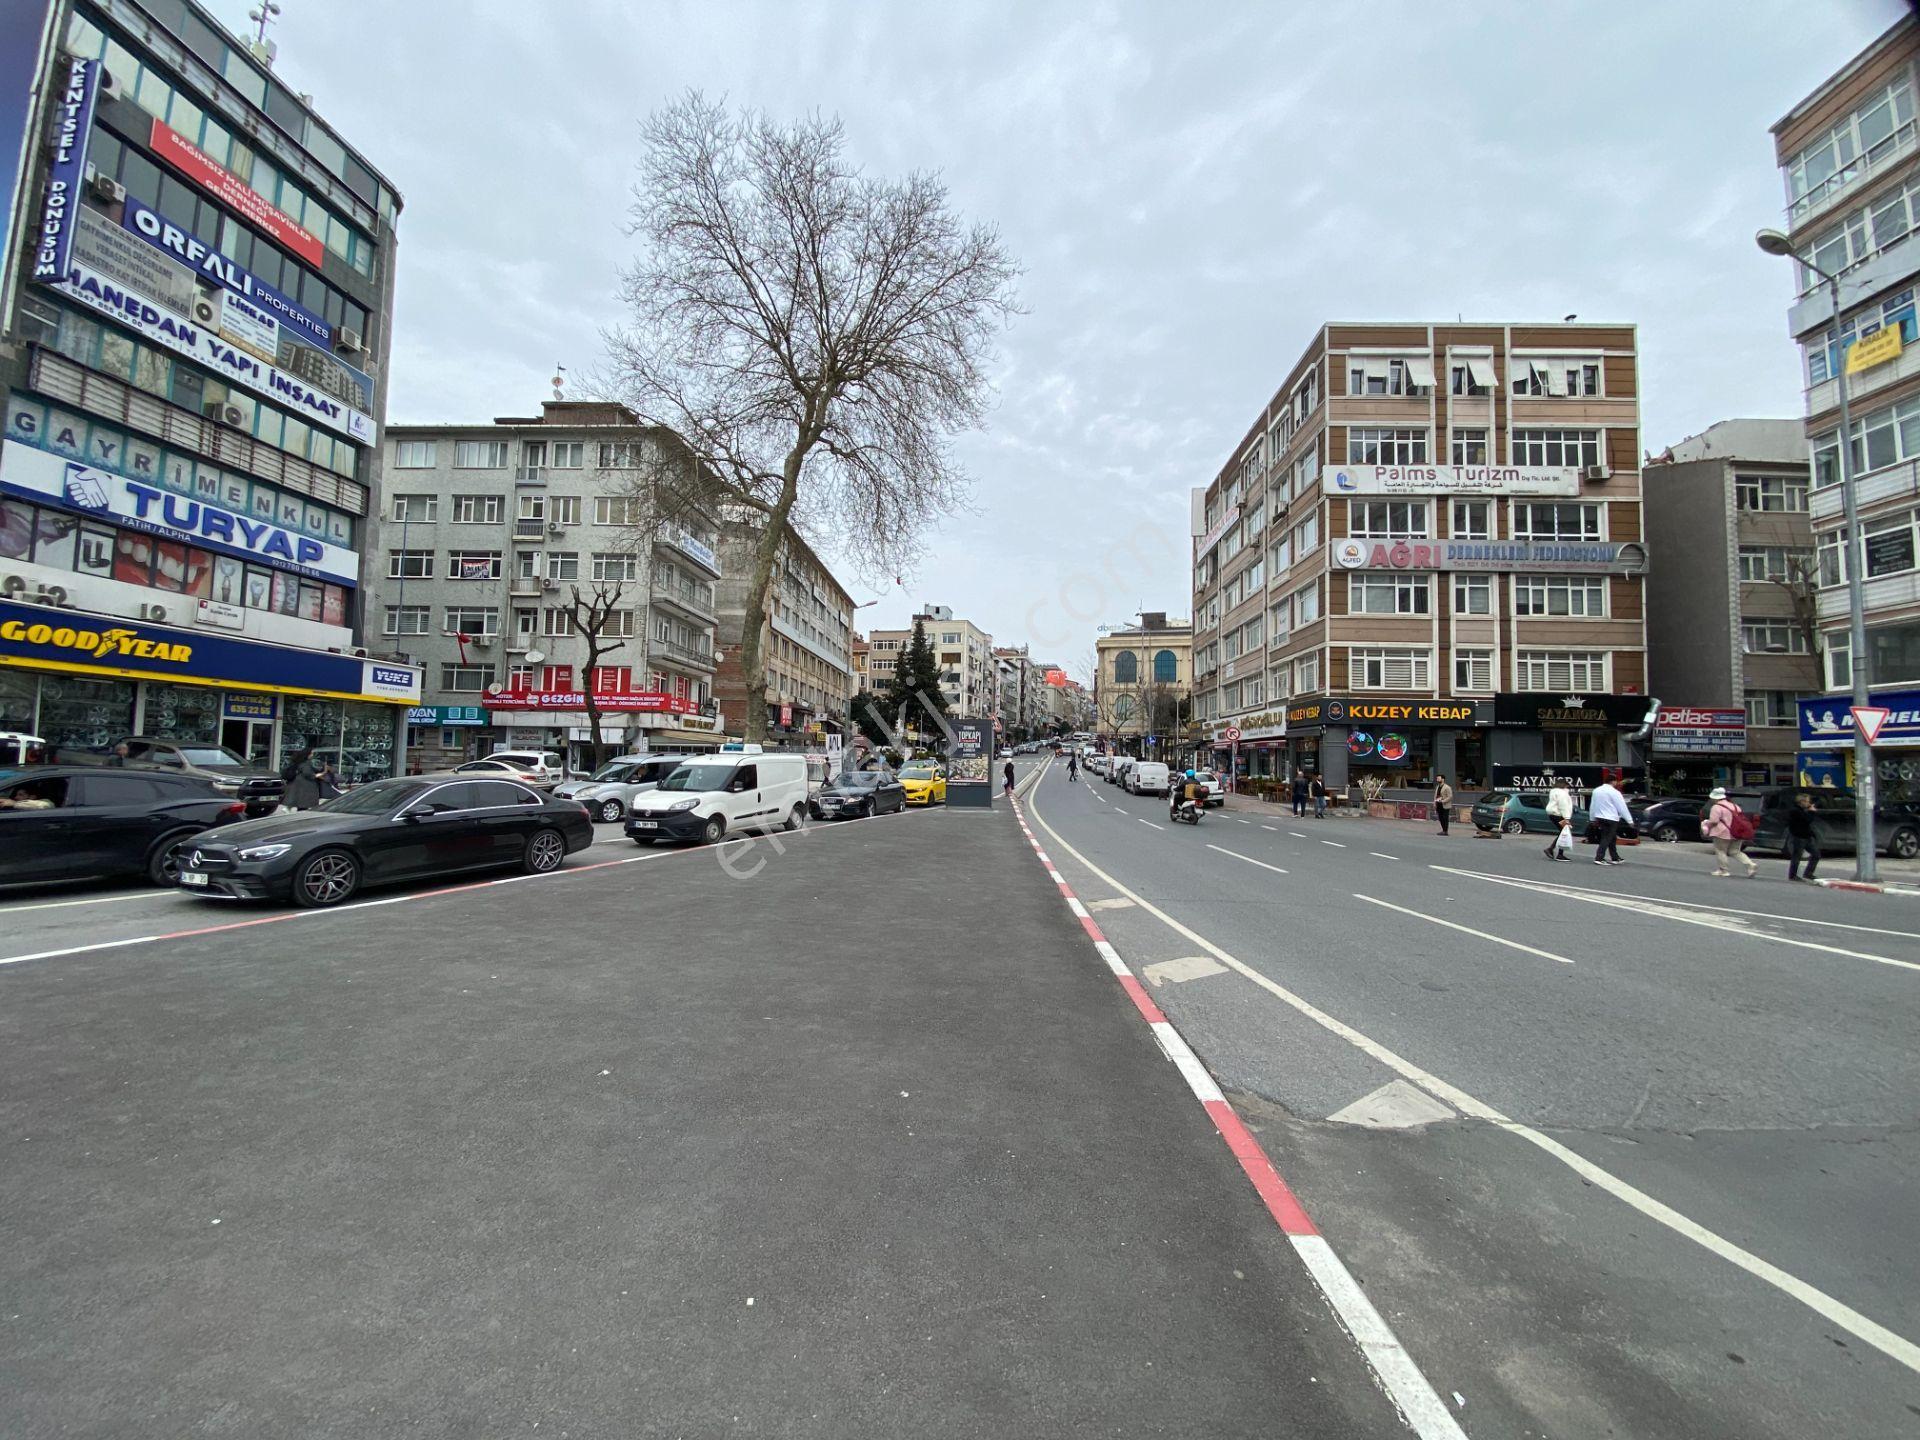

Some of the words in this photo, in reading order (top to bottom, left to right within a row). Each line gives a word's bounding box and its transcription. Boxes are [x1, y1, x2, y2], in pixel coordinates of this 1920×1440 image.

[57, 60, 87, 163] KENTSEL
[205, 179, 239, 212] GENEL
[134, 208, 253, 296] ORFALI
[256, 287, 329, 340] PROPERTIES
[70, 268, 198, 347] HANEDAN
[207, 338, 260, 379] YAPI
[1375, 465, 1437, 481] Palms
[1452, 465, 1520, 481] Turizm
[126, 481, 324, 564] TURYAP
[158, 526, 192, 543] ALPHA
[1368, 540, 1442, 569] AĞRI
[541, 693, 585, 705] GEZGİN
[1348, 705, 1413, 719] KUZEY
[1418, 707, 1472, 720] KEBAP
[1537, 708, 1608, 721] SAYANORA
[1656, 709, 1713, 727] petlas
